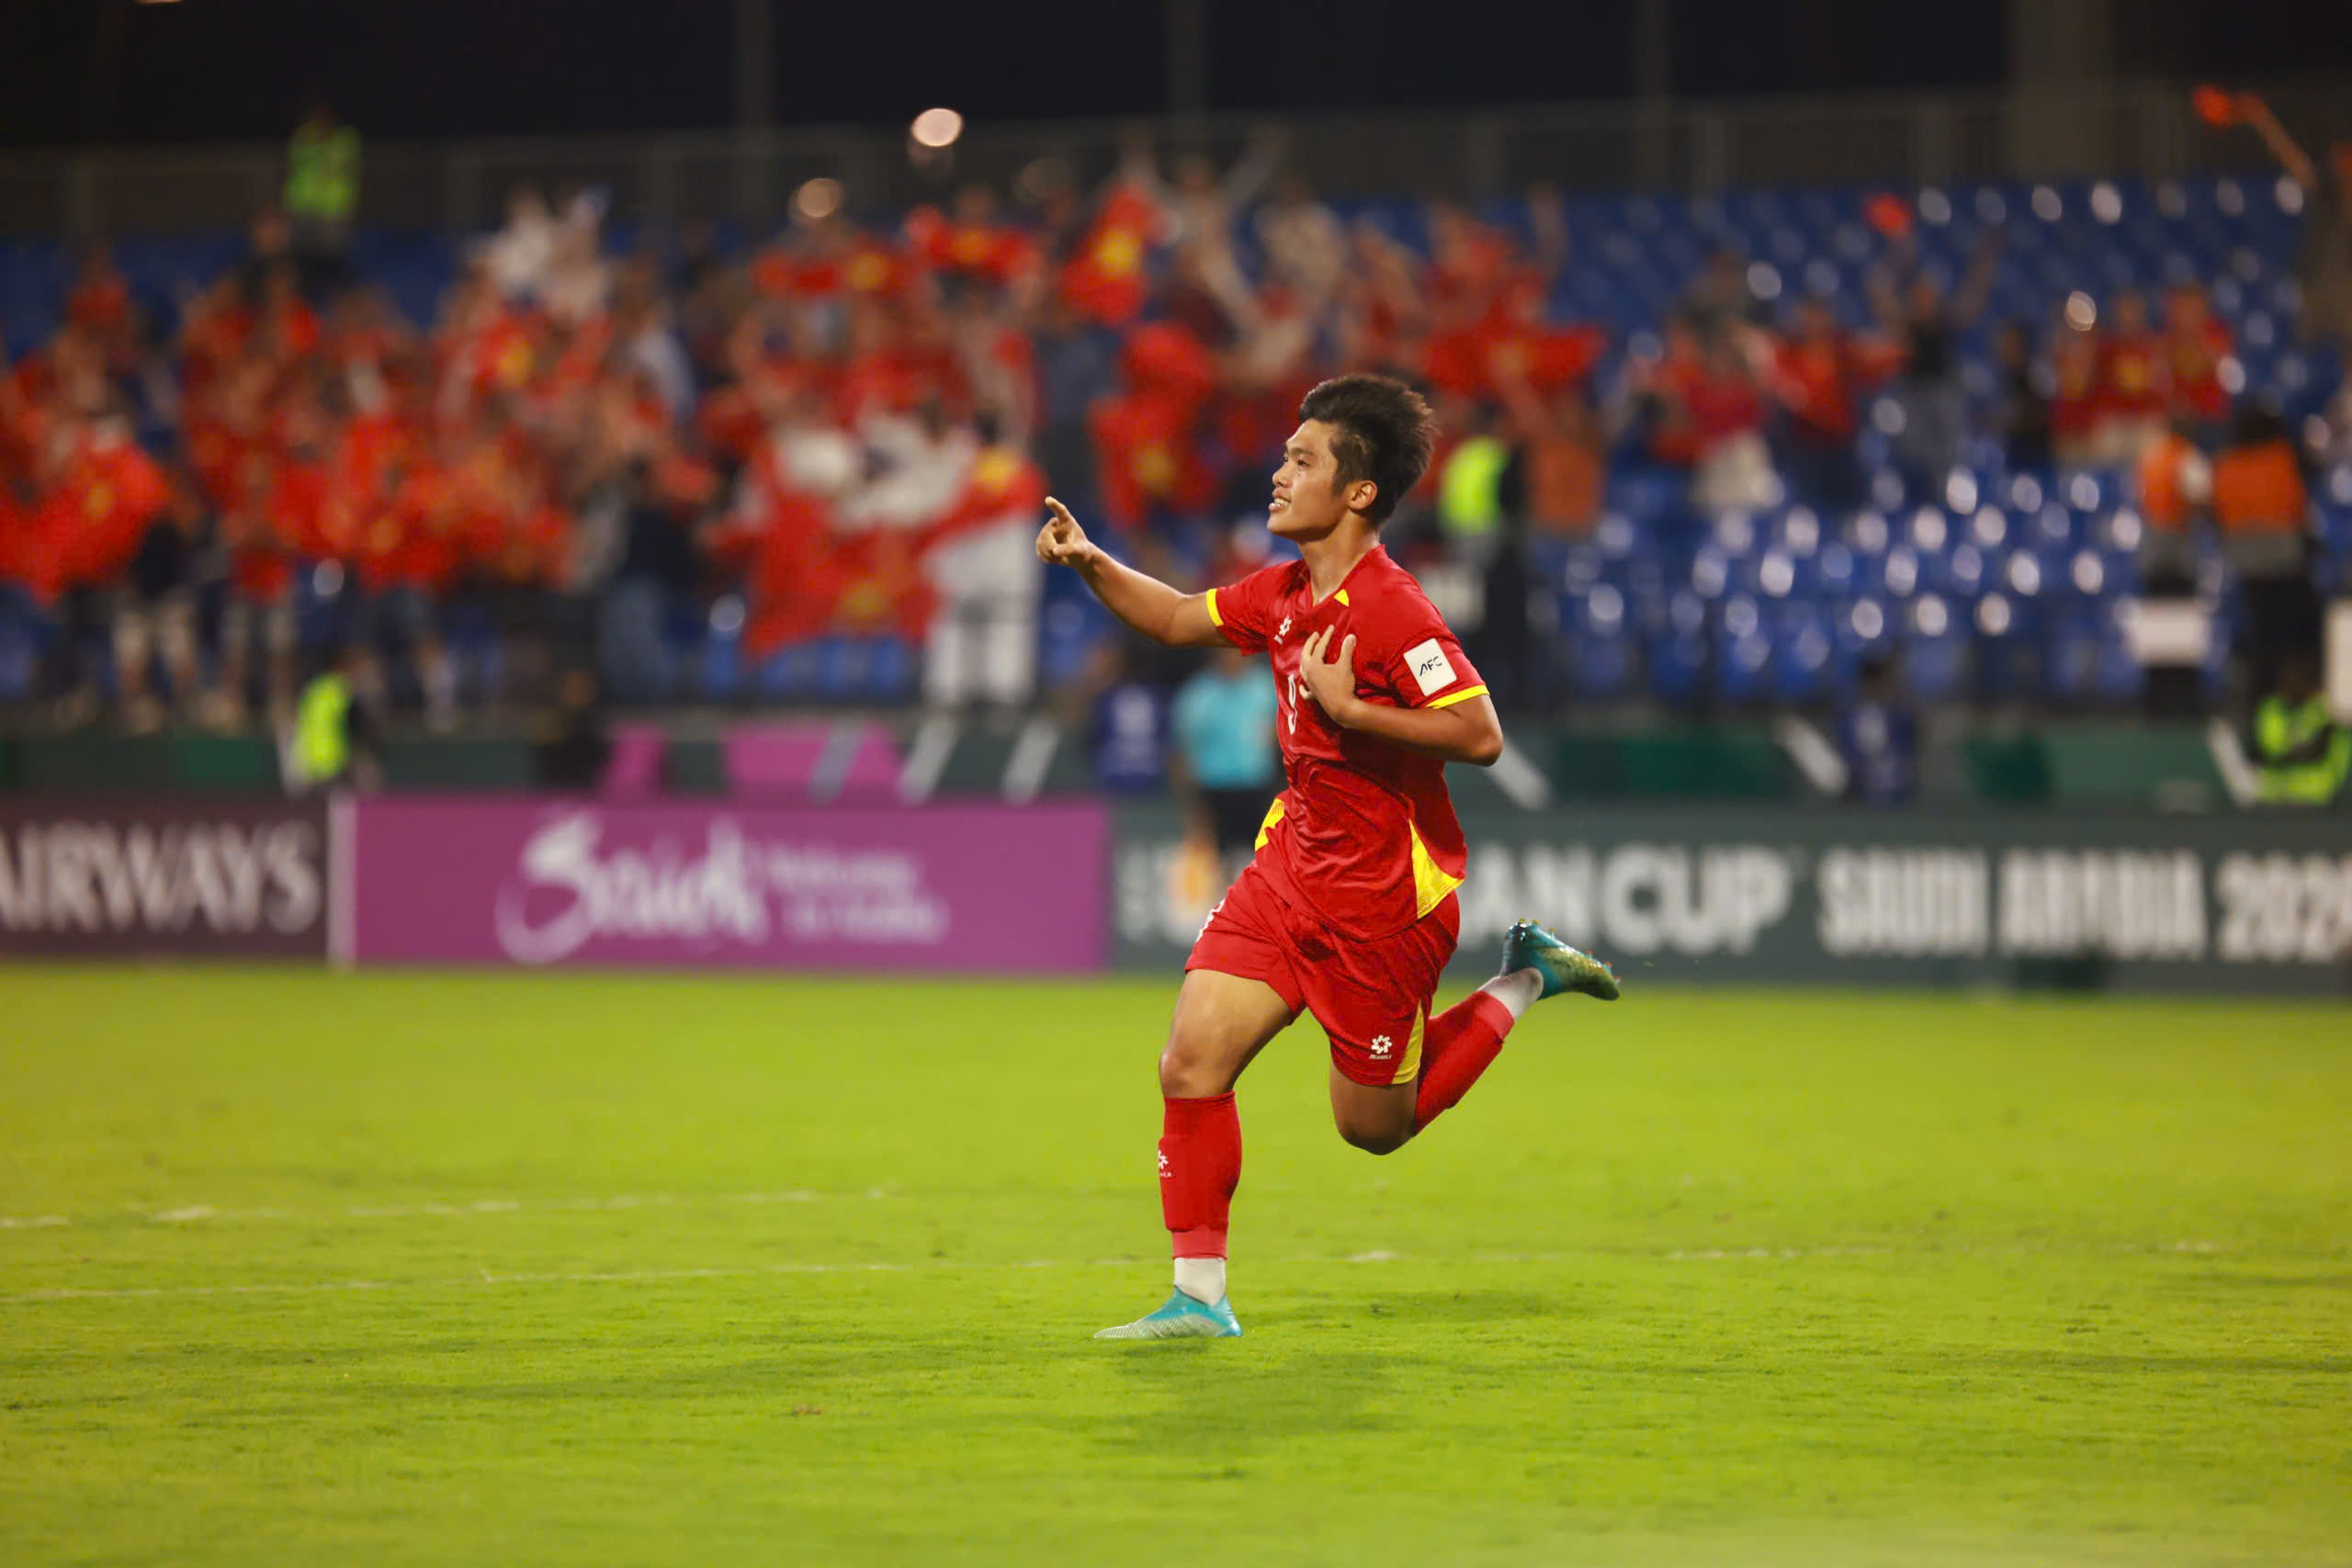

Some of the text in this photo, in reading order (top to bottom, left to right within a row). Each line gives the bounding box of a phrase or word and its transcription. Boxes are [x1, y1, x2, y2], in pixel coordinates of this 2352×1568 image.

[1419, 656, 1442, 676] AFC
[1601, 846, 1788, 953] CUP
[2218, 852, 2352, 961] 202
